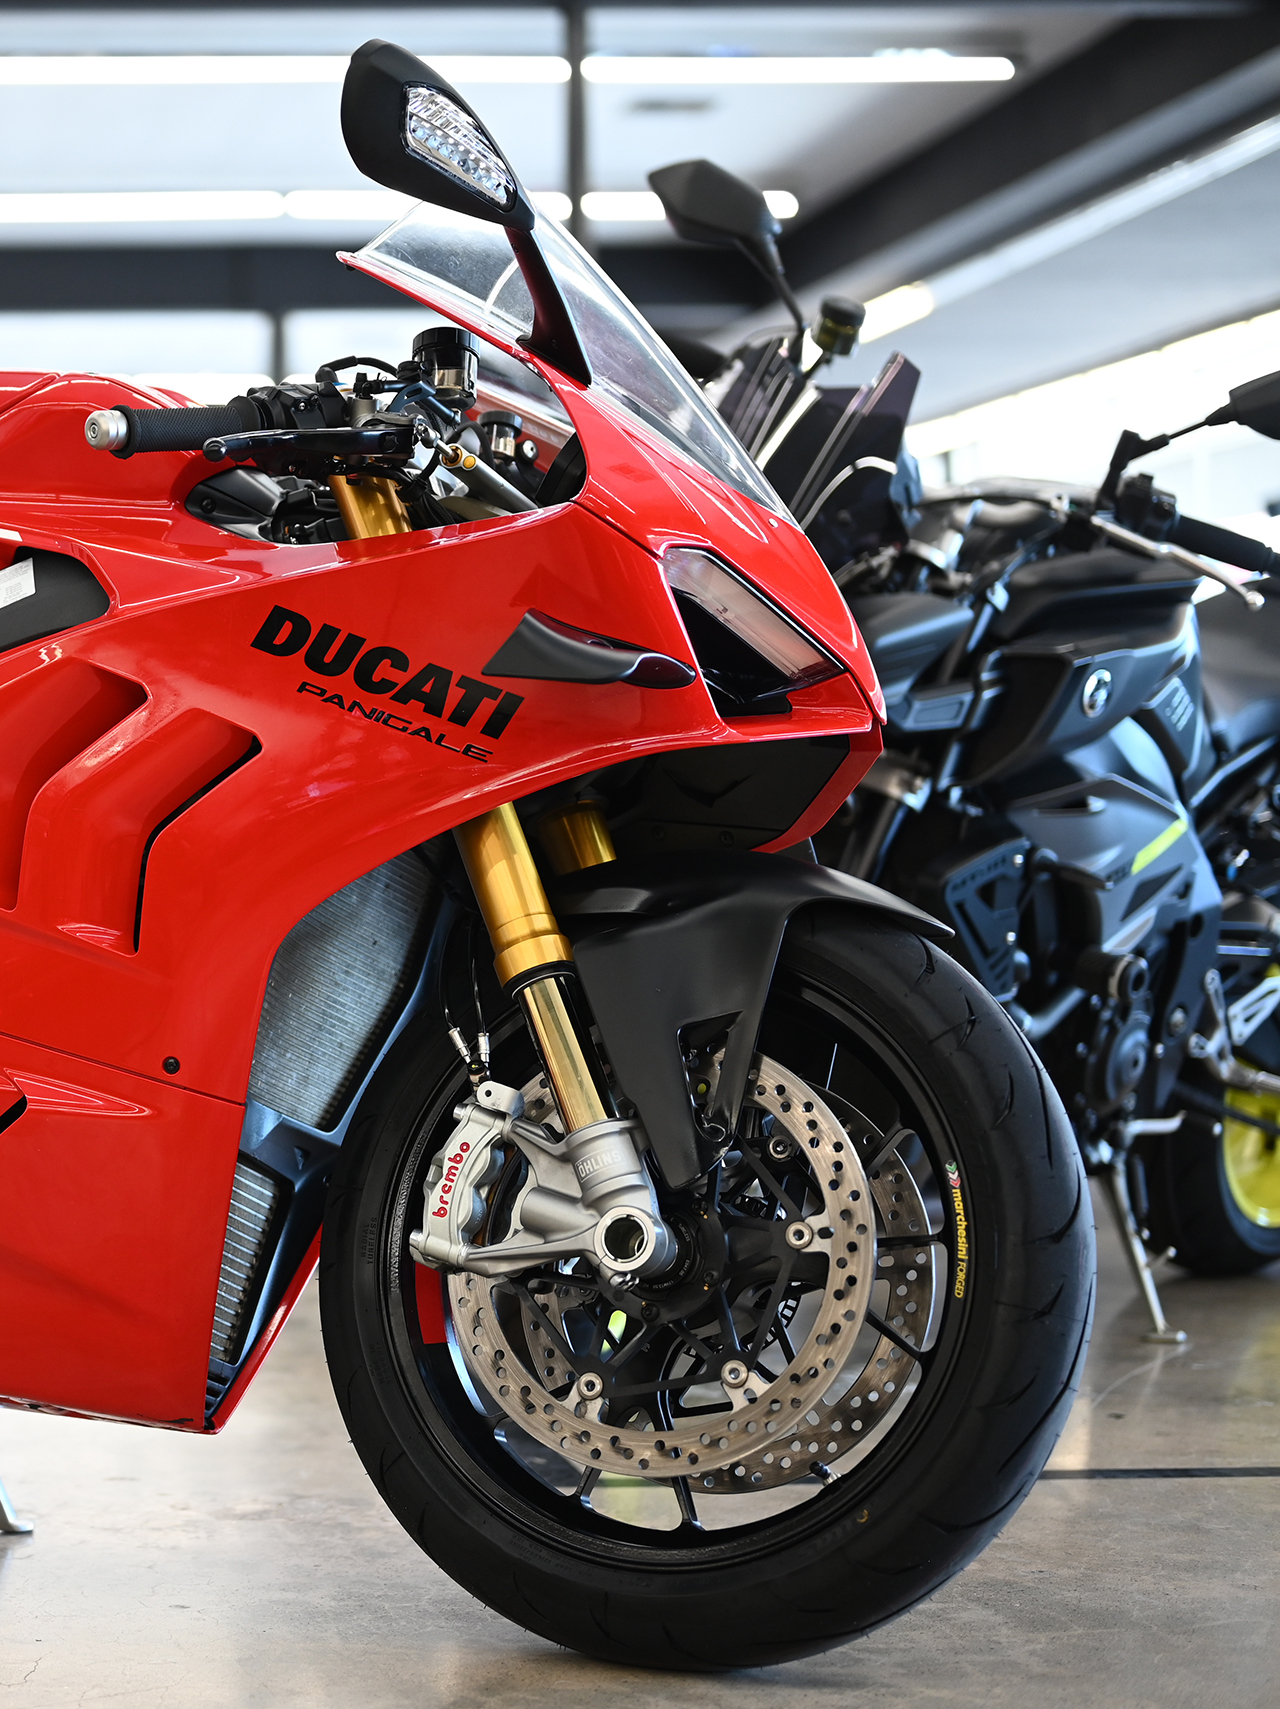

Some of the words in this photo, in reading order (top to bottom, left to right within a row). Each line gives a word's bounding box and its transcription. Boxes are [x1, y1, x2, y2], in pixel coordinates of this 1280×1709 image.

[250, 604, 525, 740] DUCATI
[296, 681, 494, 763] PANIGALE
[432, 1142, 471, 1218] brembo
[578, 1151, 623, 1179] ÖHLINS
[952, 1189, 969, 1260] marchesini
[954, 1261, 967, 1299] FORGED
